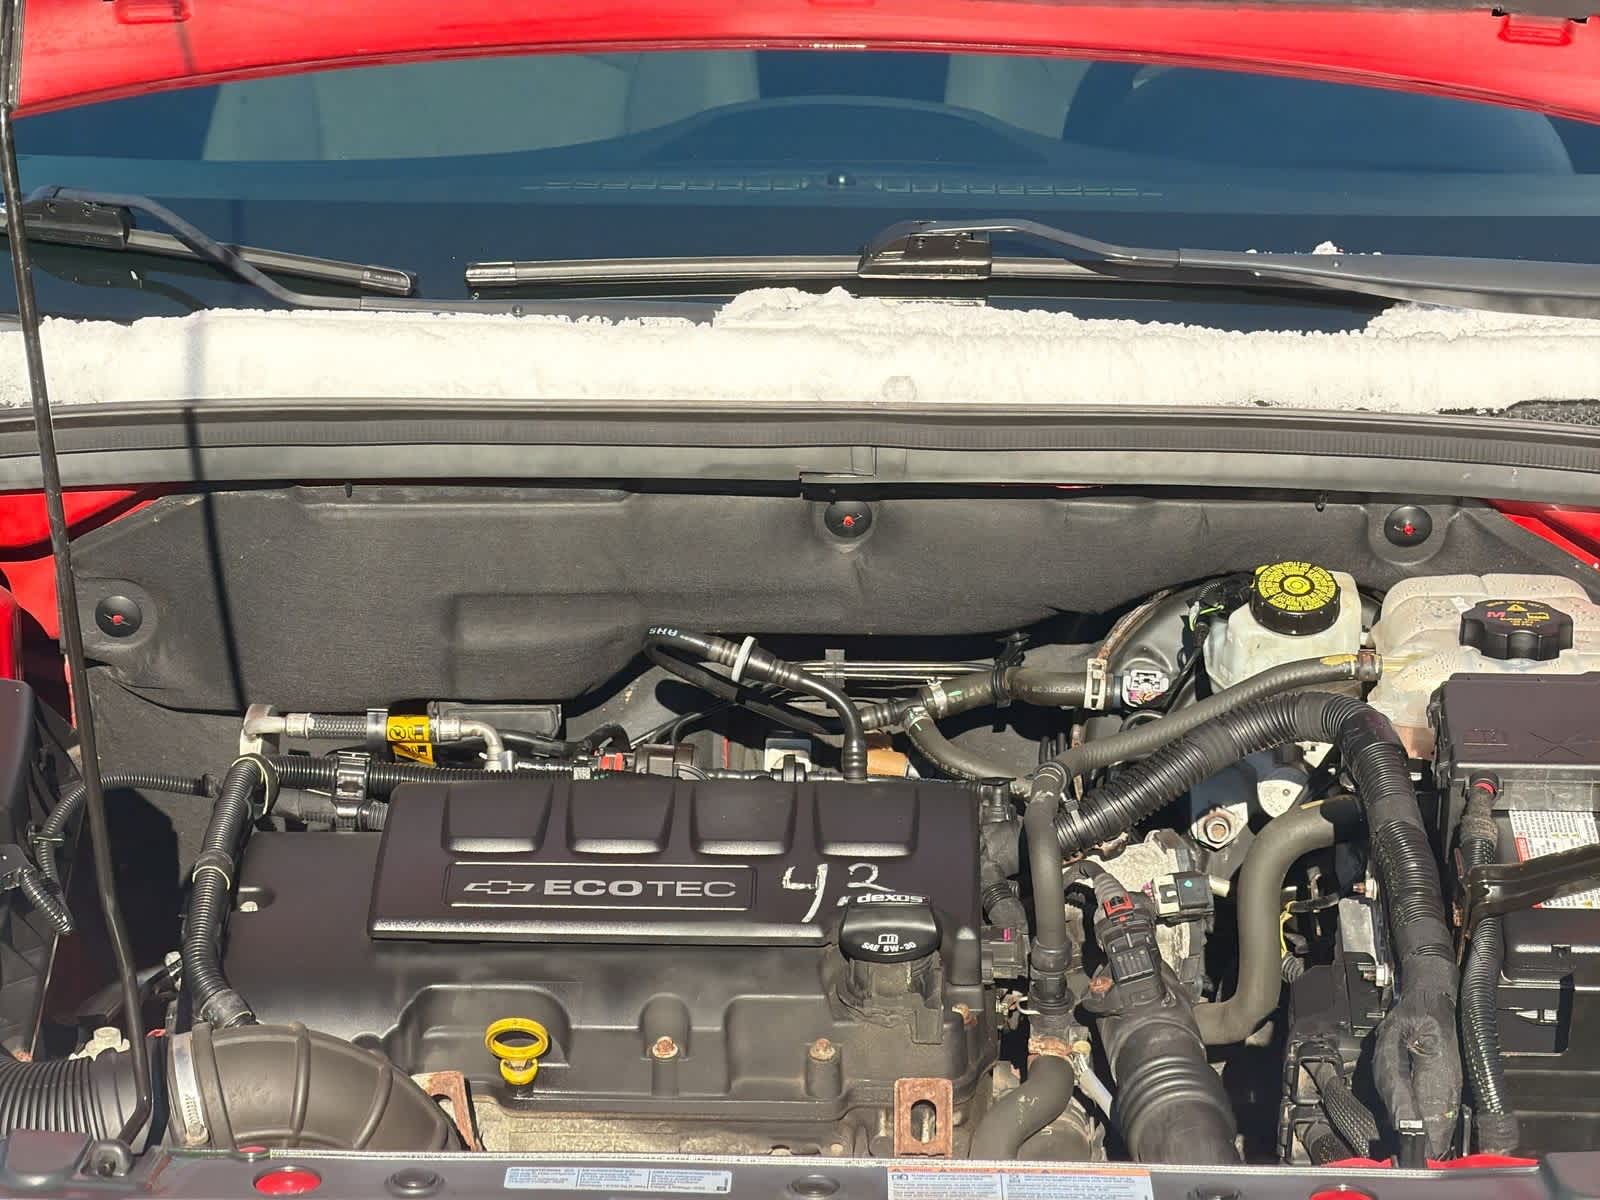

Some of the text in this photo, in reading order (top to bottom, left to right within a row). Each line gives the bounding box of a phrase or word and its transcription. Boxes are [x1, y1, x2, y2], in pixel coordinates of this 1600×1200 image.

[543, 879, 737, 897] ECOTEC
[856, 893, 924, 904] dexos
[861, 941, 917, 952] SAE 5W-30
